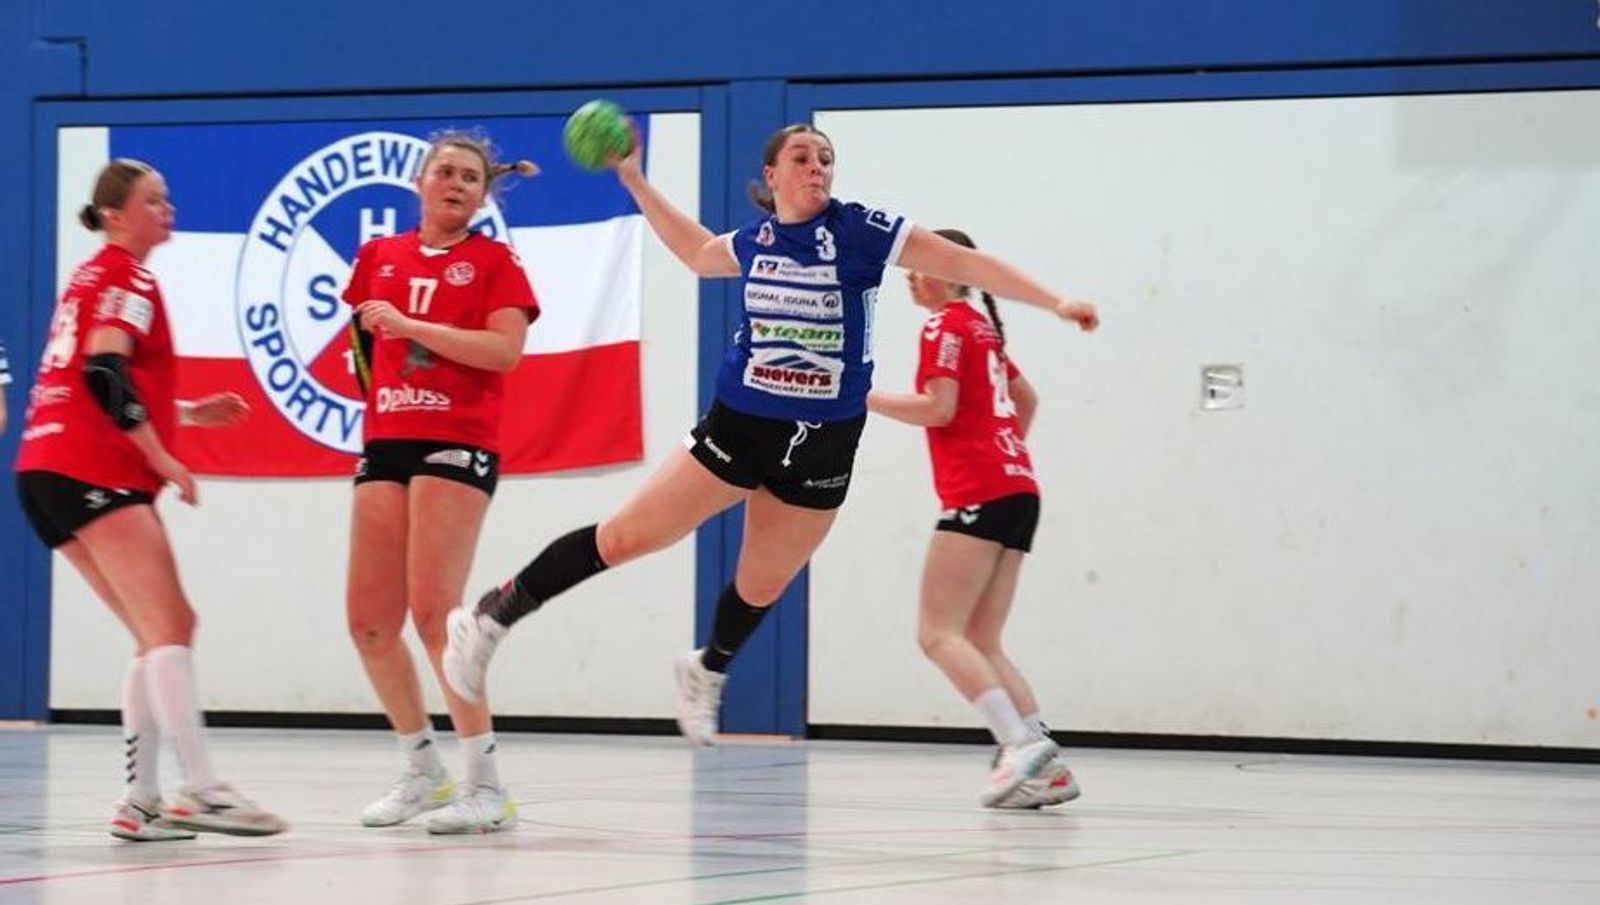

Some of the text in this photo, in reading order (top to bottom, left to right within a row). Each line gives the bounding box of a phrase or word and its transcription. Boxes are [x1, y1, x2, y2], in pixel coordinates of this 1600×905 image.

[815, 224, 837, 262] 3
[307, 273, 339, 321] S
[408, 277, 439, 315] 17
[772, 325, 842, 342] team
